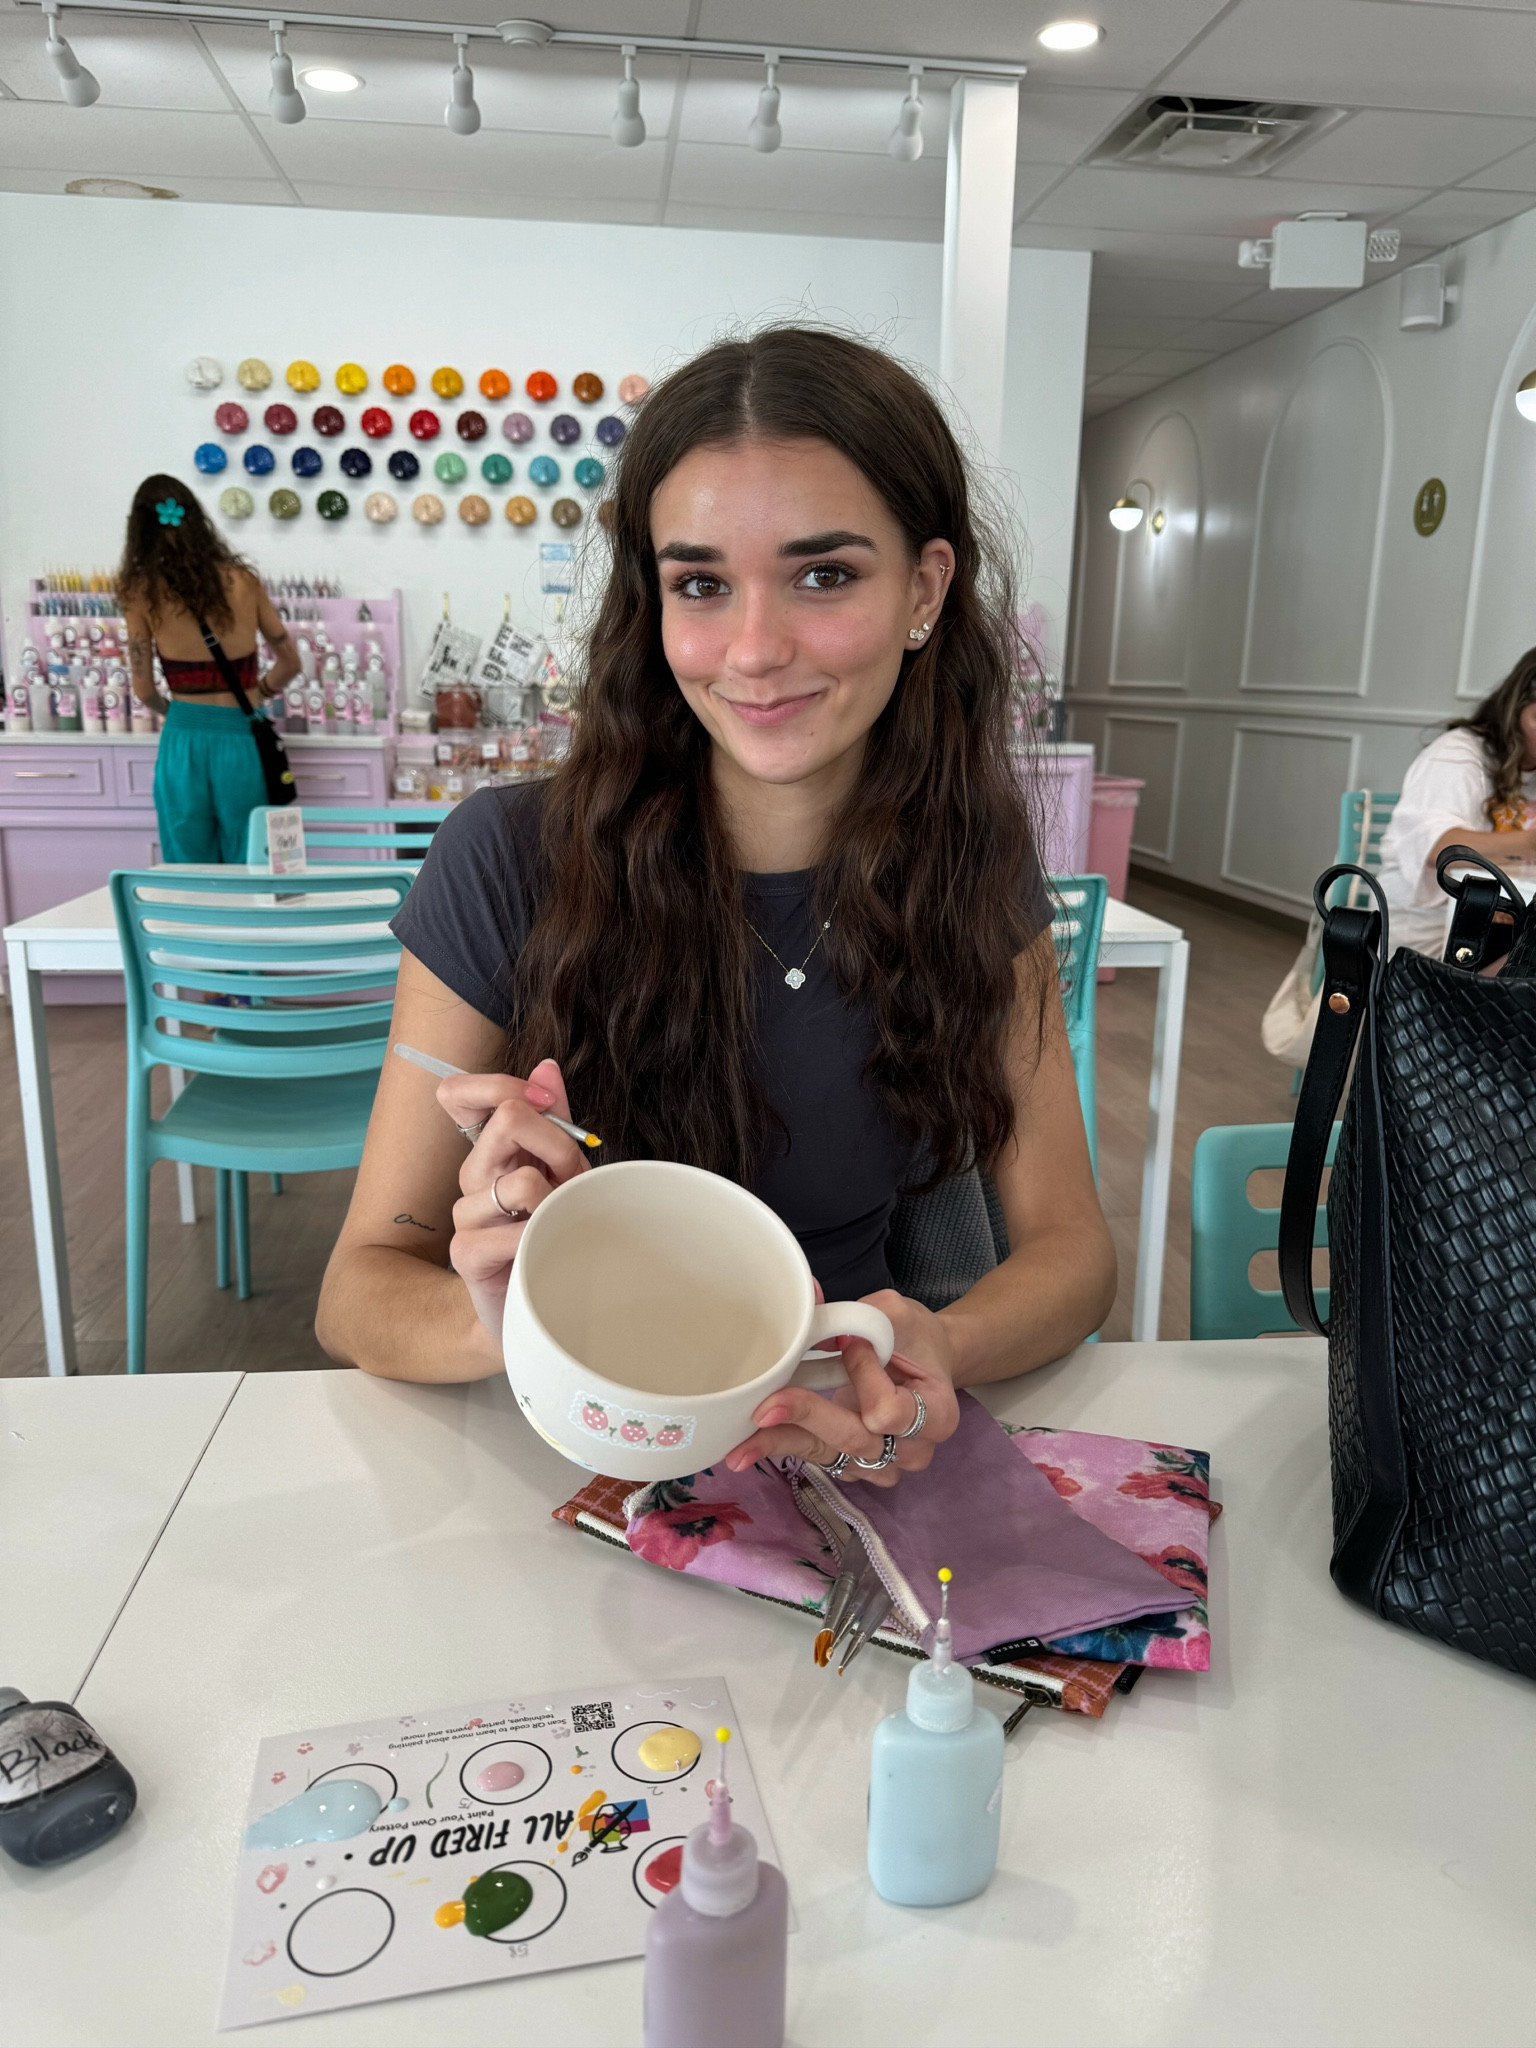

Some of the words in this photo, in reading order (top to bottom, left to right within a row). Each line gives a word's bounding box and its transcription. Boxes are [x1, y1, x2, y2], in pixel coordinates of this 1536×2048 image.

[507, 1714, 554, 1724] techniques,
[548, 1718, 567, 1726] Scan
[475, 1728, 497, 1736] learn
[509, 1724, 530, 1732] code
[401, 1732, 426, 1741] more!
[427, 1729, 443, 1738] and
[451, 1731, 474, 1740] more
[388, 1737, 423, 1750] painting
[425, 1735, 449, 1744] about
[0, 1729, 101, 1784] Black
[440, 1813, 464, 1823] Your
[467, 1809, 494, 1818] Paint
[412, 1818, 437, 1826] Own
[368, 1822, 409, 1833] Pottery
[523, 1810, 574, 1844] ALL
[430, 1819, 510, 1858] FIRED
[368, 1834, 417, 1867] UP
